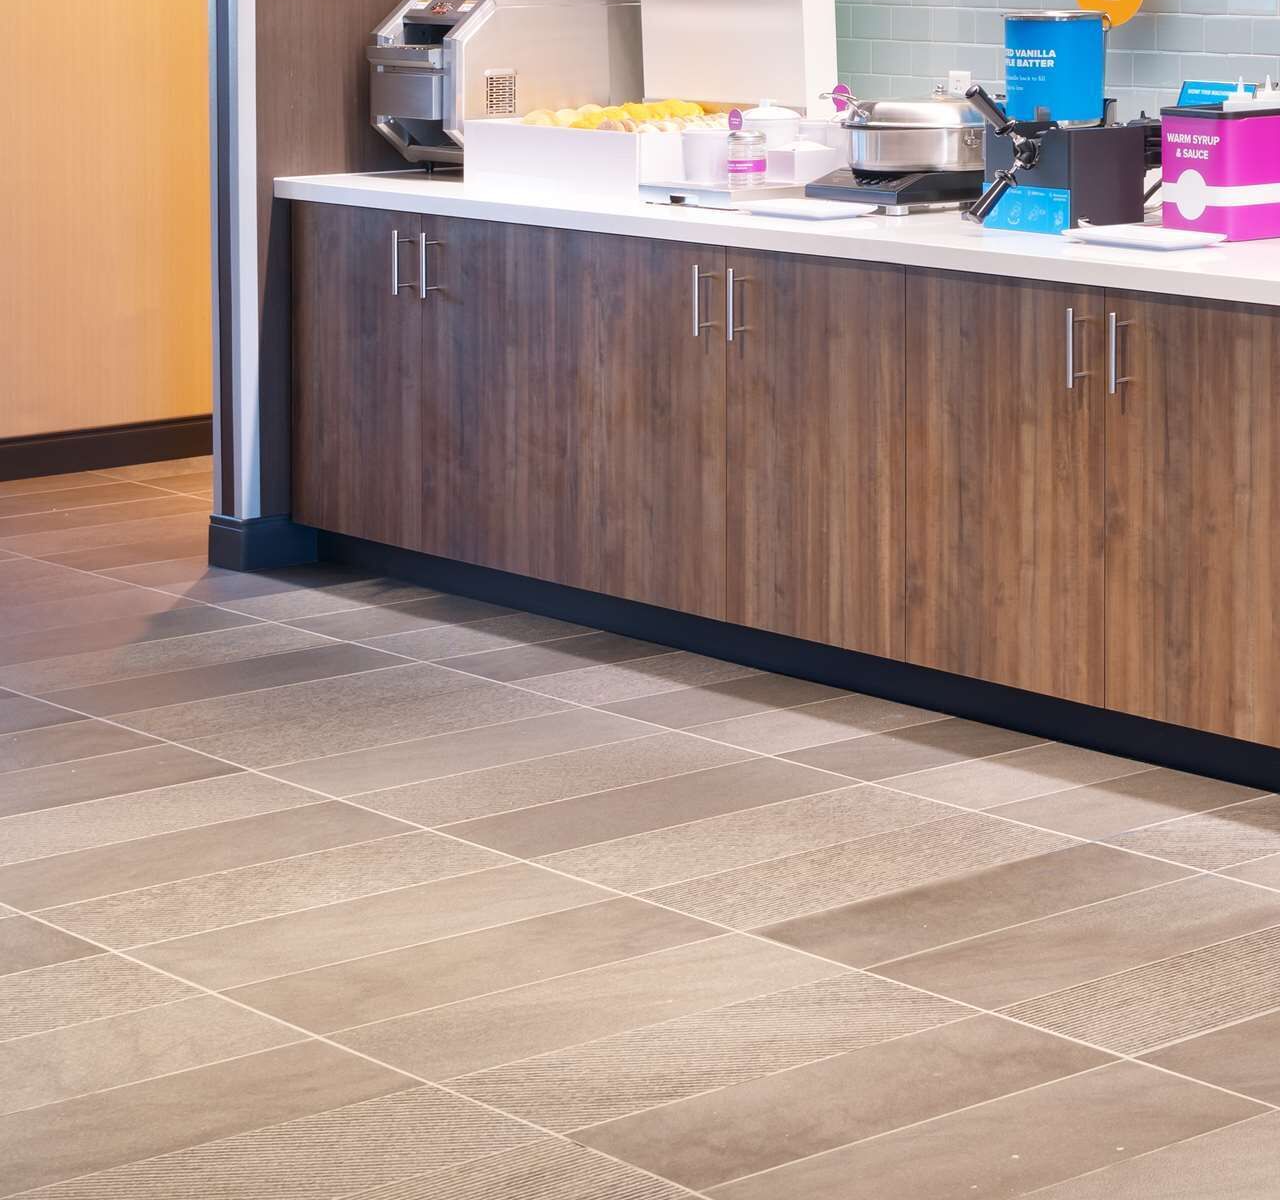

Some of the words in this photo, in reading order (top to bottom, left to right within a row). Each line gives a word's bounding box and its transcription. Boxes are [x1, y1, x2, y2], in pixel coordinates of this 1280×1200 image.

[1015, 49, 1056, 58] VANILLA
[1016, 59, 1055, 67] BATTER
[1167, 133, 1191, 144] WARM
[1192, 134, 1220, 146] SYRUP
[1175, 148, 1182, 158] &
[1183, 149, 1209, 160] SAUCE
